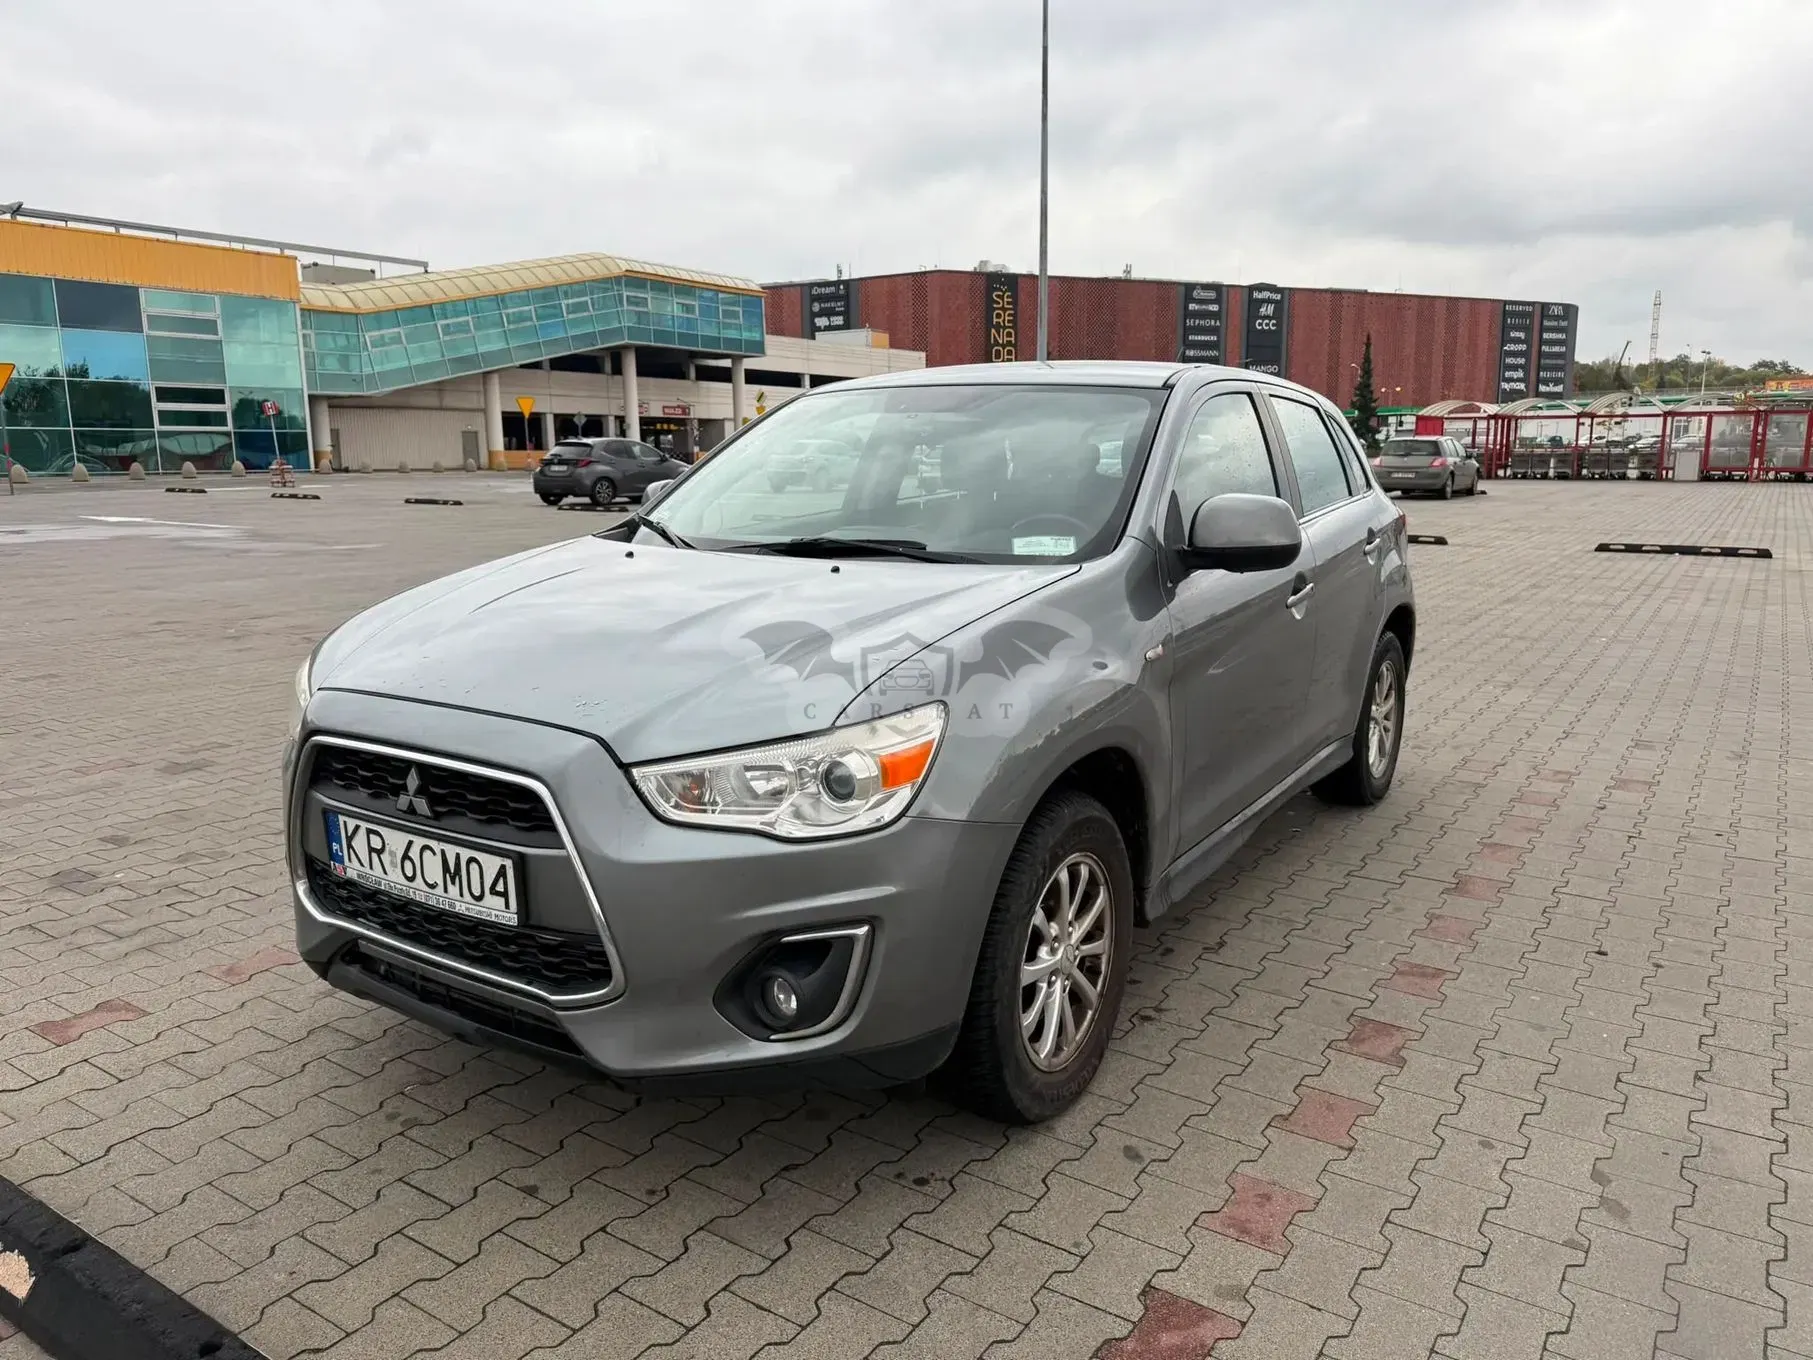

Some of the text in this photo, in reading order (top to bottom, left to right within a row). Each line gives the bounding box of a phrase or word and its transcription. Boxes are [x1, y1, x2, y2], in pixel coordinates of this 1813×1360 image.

[811, 286, 836, 295] iDream
[1253, 290, 1281, 300] HalfPrice
[1505, 304, 1533, 312] RESERVED
[1186, 318, 1221, 327] SEPHORA
[1255, 320, 1277, 330] CCC
[1185, 349, 1219, 357] ROSSMANN
[1249, 365, 1279, 373] MANGO
[1504, 368, 1525, 379] empik
[332, 842, 343, 856] PL
[343, 820, 511, 911] KR 6CM04
[464, 906, 493, 919] MITSUBISHI
[494, 913, 517, 925] MOTORS
